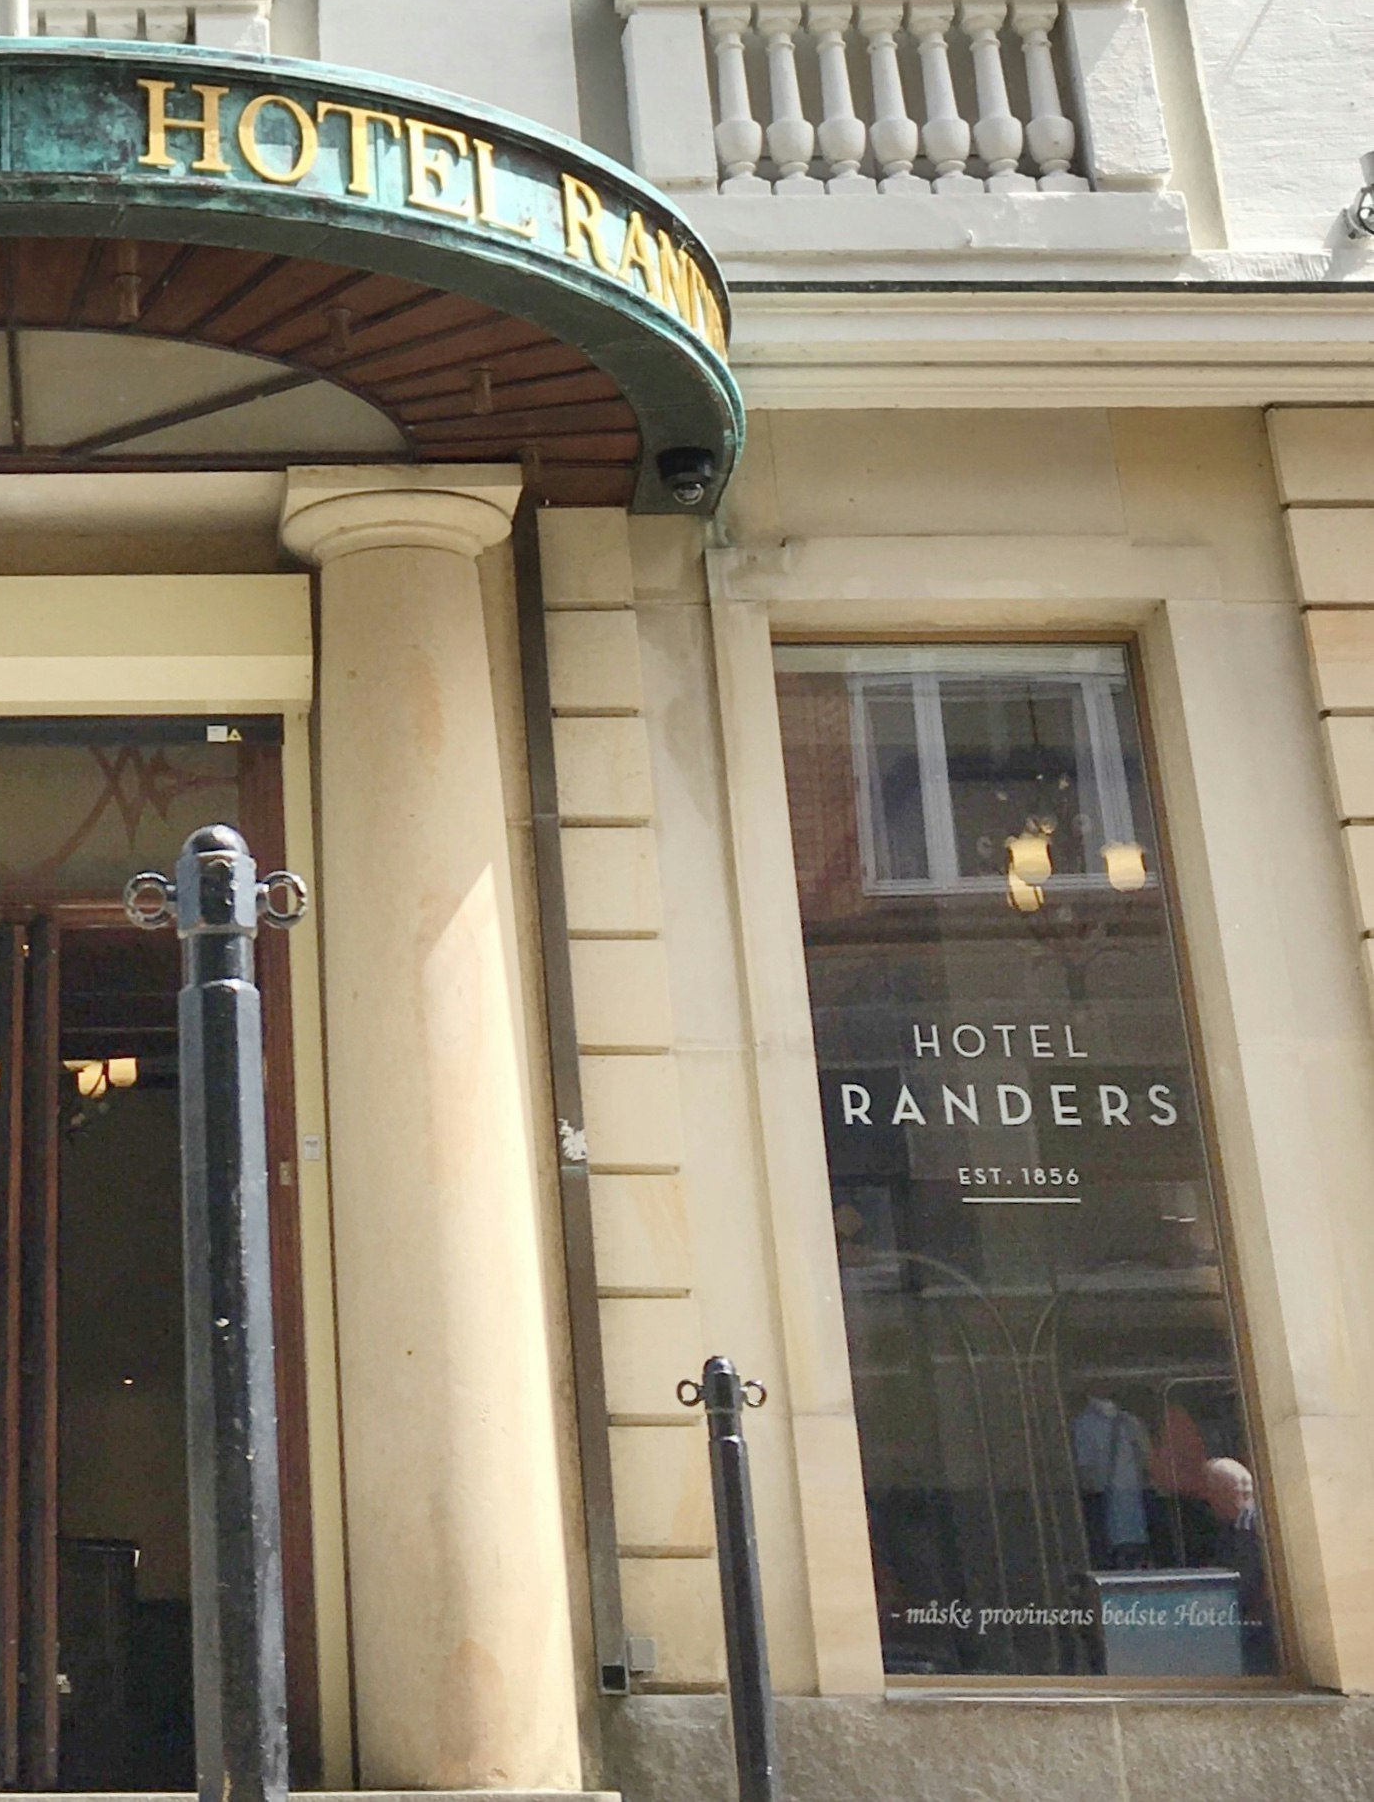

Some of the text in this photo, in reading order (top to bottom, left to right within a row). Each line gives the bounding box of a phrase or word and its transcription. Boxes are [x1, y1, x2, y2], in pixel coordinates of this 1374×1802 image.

[136, 78, 537, 240] HOTEL
[913, 1024, 1089, 1059] HOTEL
[839, 1083, 1178, 1127] RANDERS
[958, 1167, 1081, 1186] EST. 1856
[905, 1598, 974, 1629] måske
[978, 1603, 1094, 1635] provinsens
[1101, 1600, 1167, 1627] bedste
